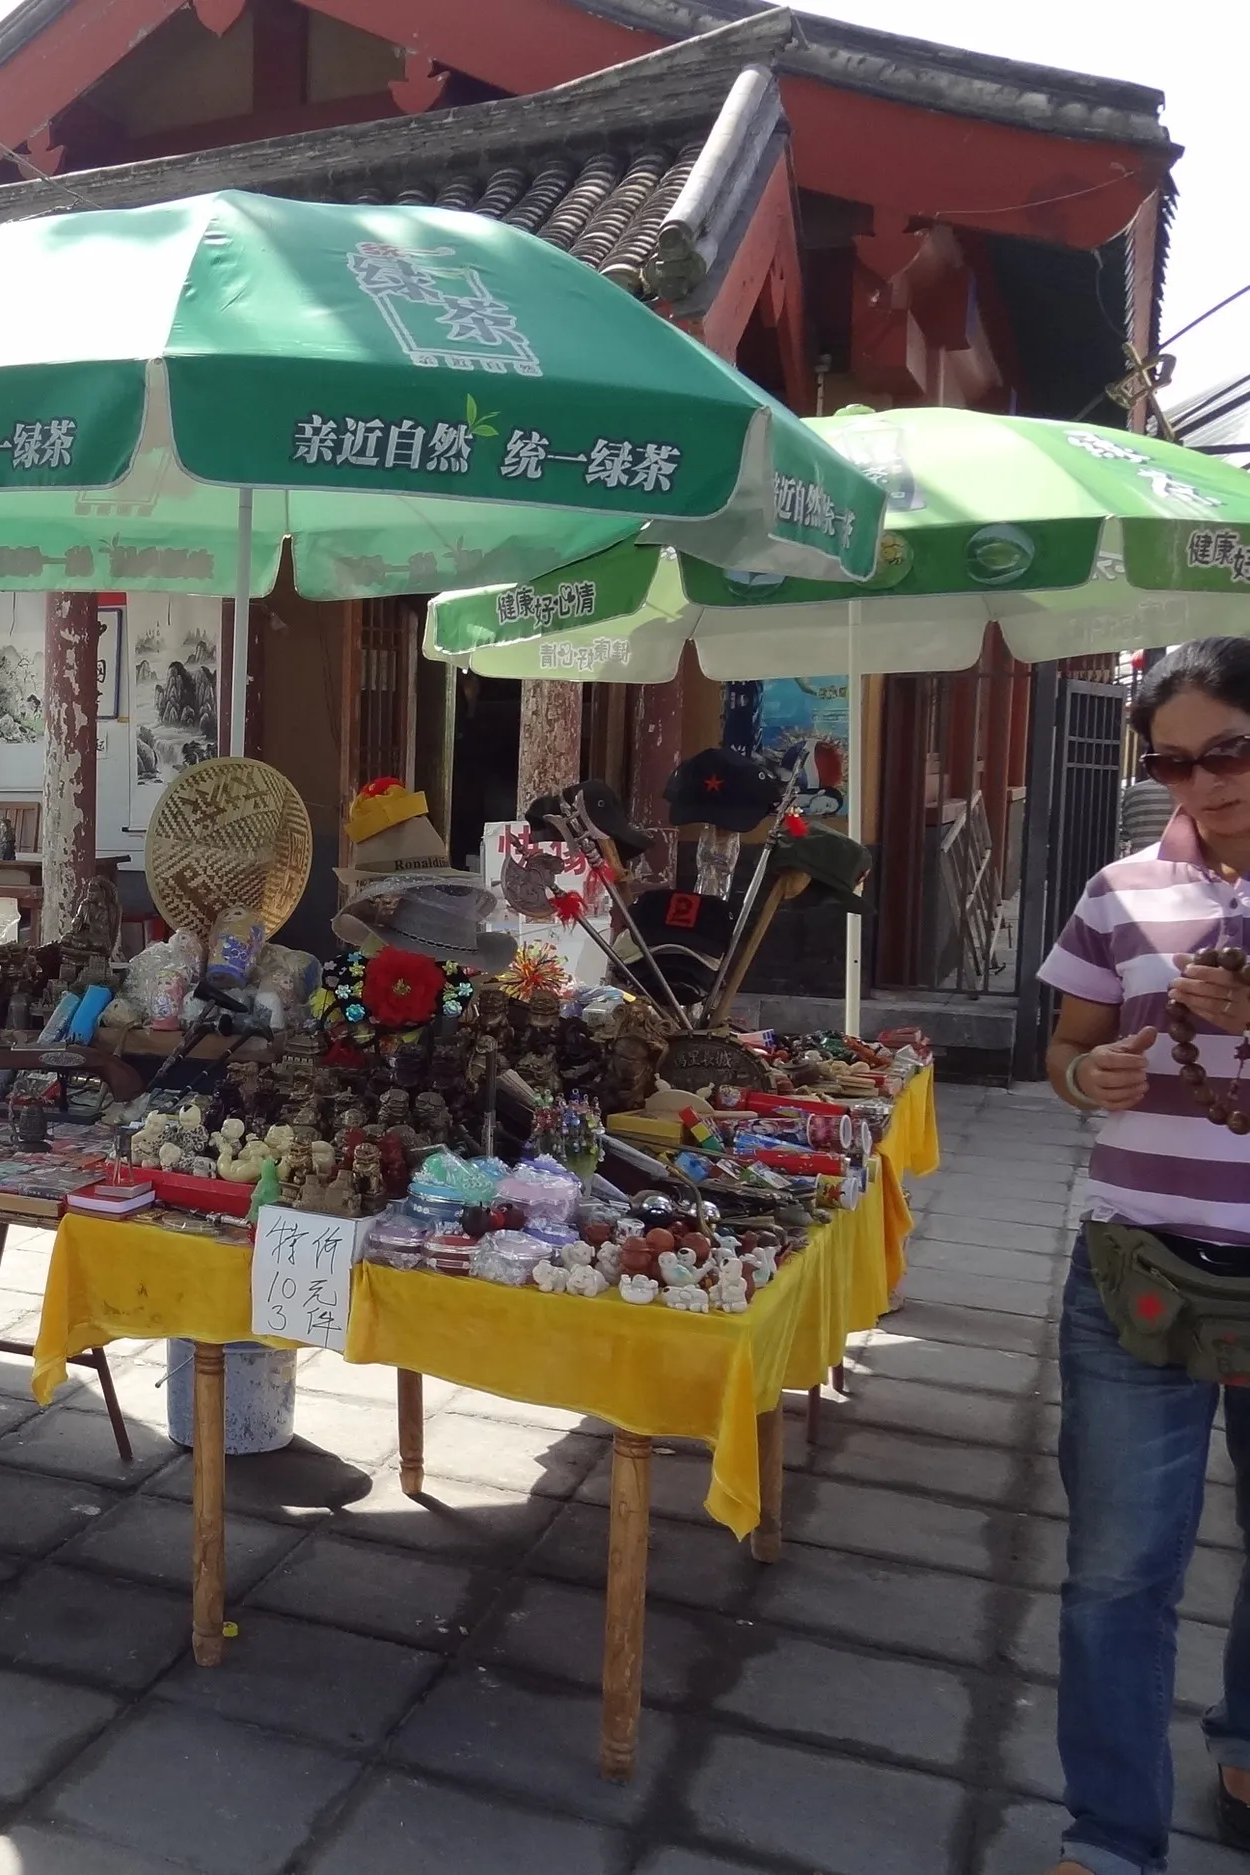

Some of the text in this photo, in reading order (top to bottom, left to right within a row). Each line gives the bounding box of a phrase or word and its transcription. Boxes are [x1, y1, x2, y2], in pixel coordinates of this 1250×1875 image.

[292, 413, 682, 493] 亲近自然 统一绿茶
[496, 582, 597, 629] 健康好心情
[265, 1216, 343, 1275] 特价
